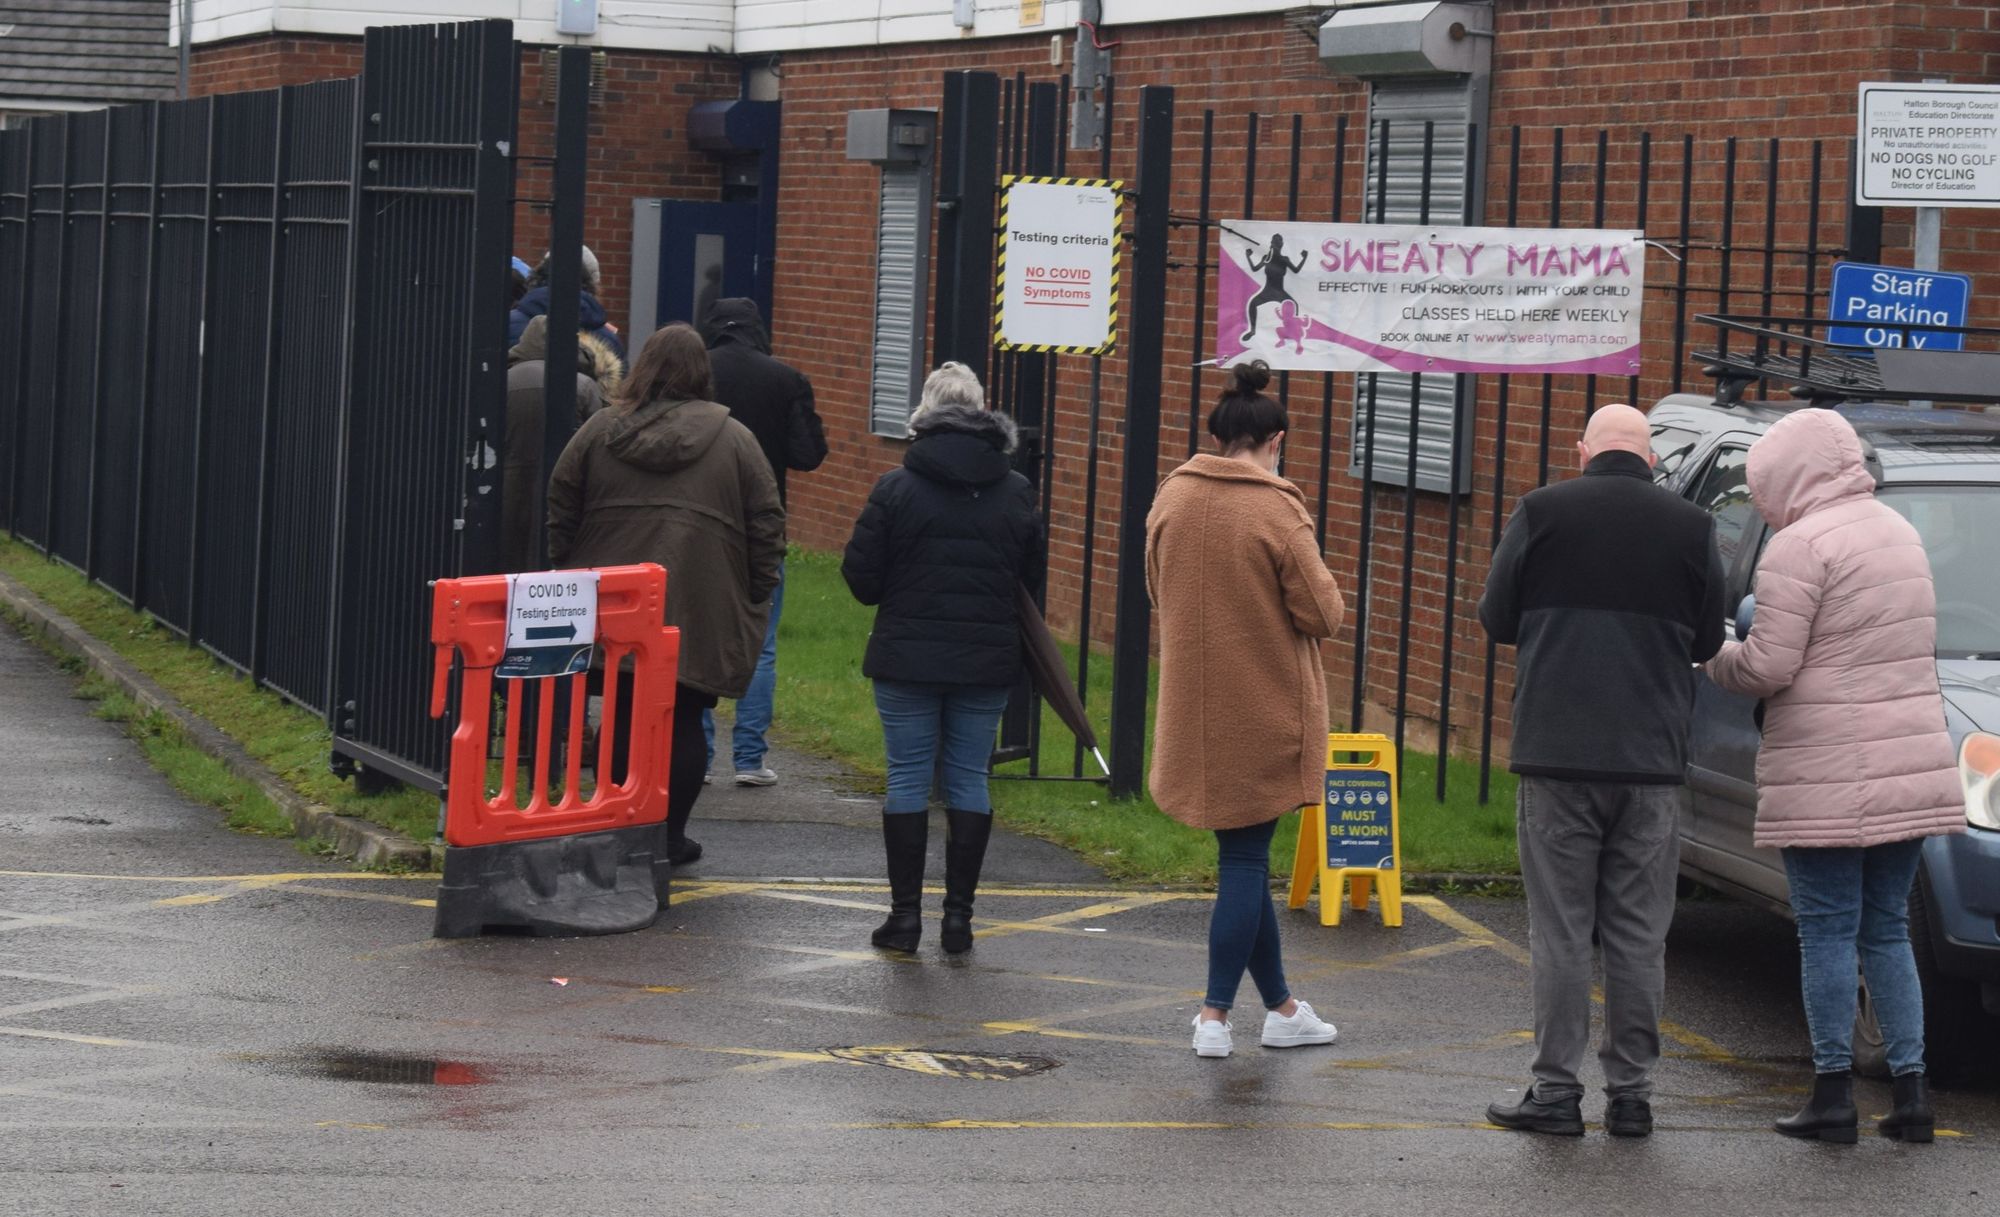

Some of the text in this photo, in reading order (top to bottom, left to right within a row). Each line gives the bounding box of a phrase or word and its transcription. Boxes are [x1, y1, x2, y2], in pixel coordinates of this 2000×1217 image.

[1904, 100, 1999, 109] Halton Borough Council
[1909, 111, 1994, 120] Education Directorate
[1871, 127, 1998, 139] PRIVATE PROPERTY
[1884, 140, 1895, 148] No
[1898, 141, 1950, 149] unauthorised
[1871, 152, 1998, 165] NO DOGS NO GOLF
[1892, 168, 1975, 180] NO CYCLING
[1891, 181, 1923, 189] Director
[1936, 182, 1976, 190] Education
[1012, 231, 1109, 246] Testing criteria
[1320, 238, 1630, 277] SWEATY MAMA
[1026, 267, 1091, 279] NO COVID
[1318, 282, 1630, 297] EFFECTIVE FUN WORKOUTS WITH YOUR CHILD
[1872, 273, 1933, 297] Staff
[1024, 286, 1091, 300] Symptoms
[1402, 307, 1630, 323] CLASSES HELD HERE WEEKLY
[1847, 297, 1949, 326] Parking
[1381, 333, 1628, 346] BOOK ONLINE AT www.sweatymama.com
[1864, 328, 1927, 349] Ony
[529, 583, 578, 598] COVID 19
[516, 606, 587, 620] Testing Entrance
[1341, 810, 1377, 821] MUST
[1330, 825, 1388, 837] BE WORN
